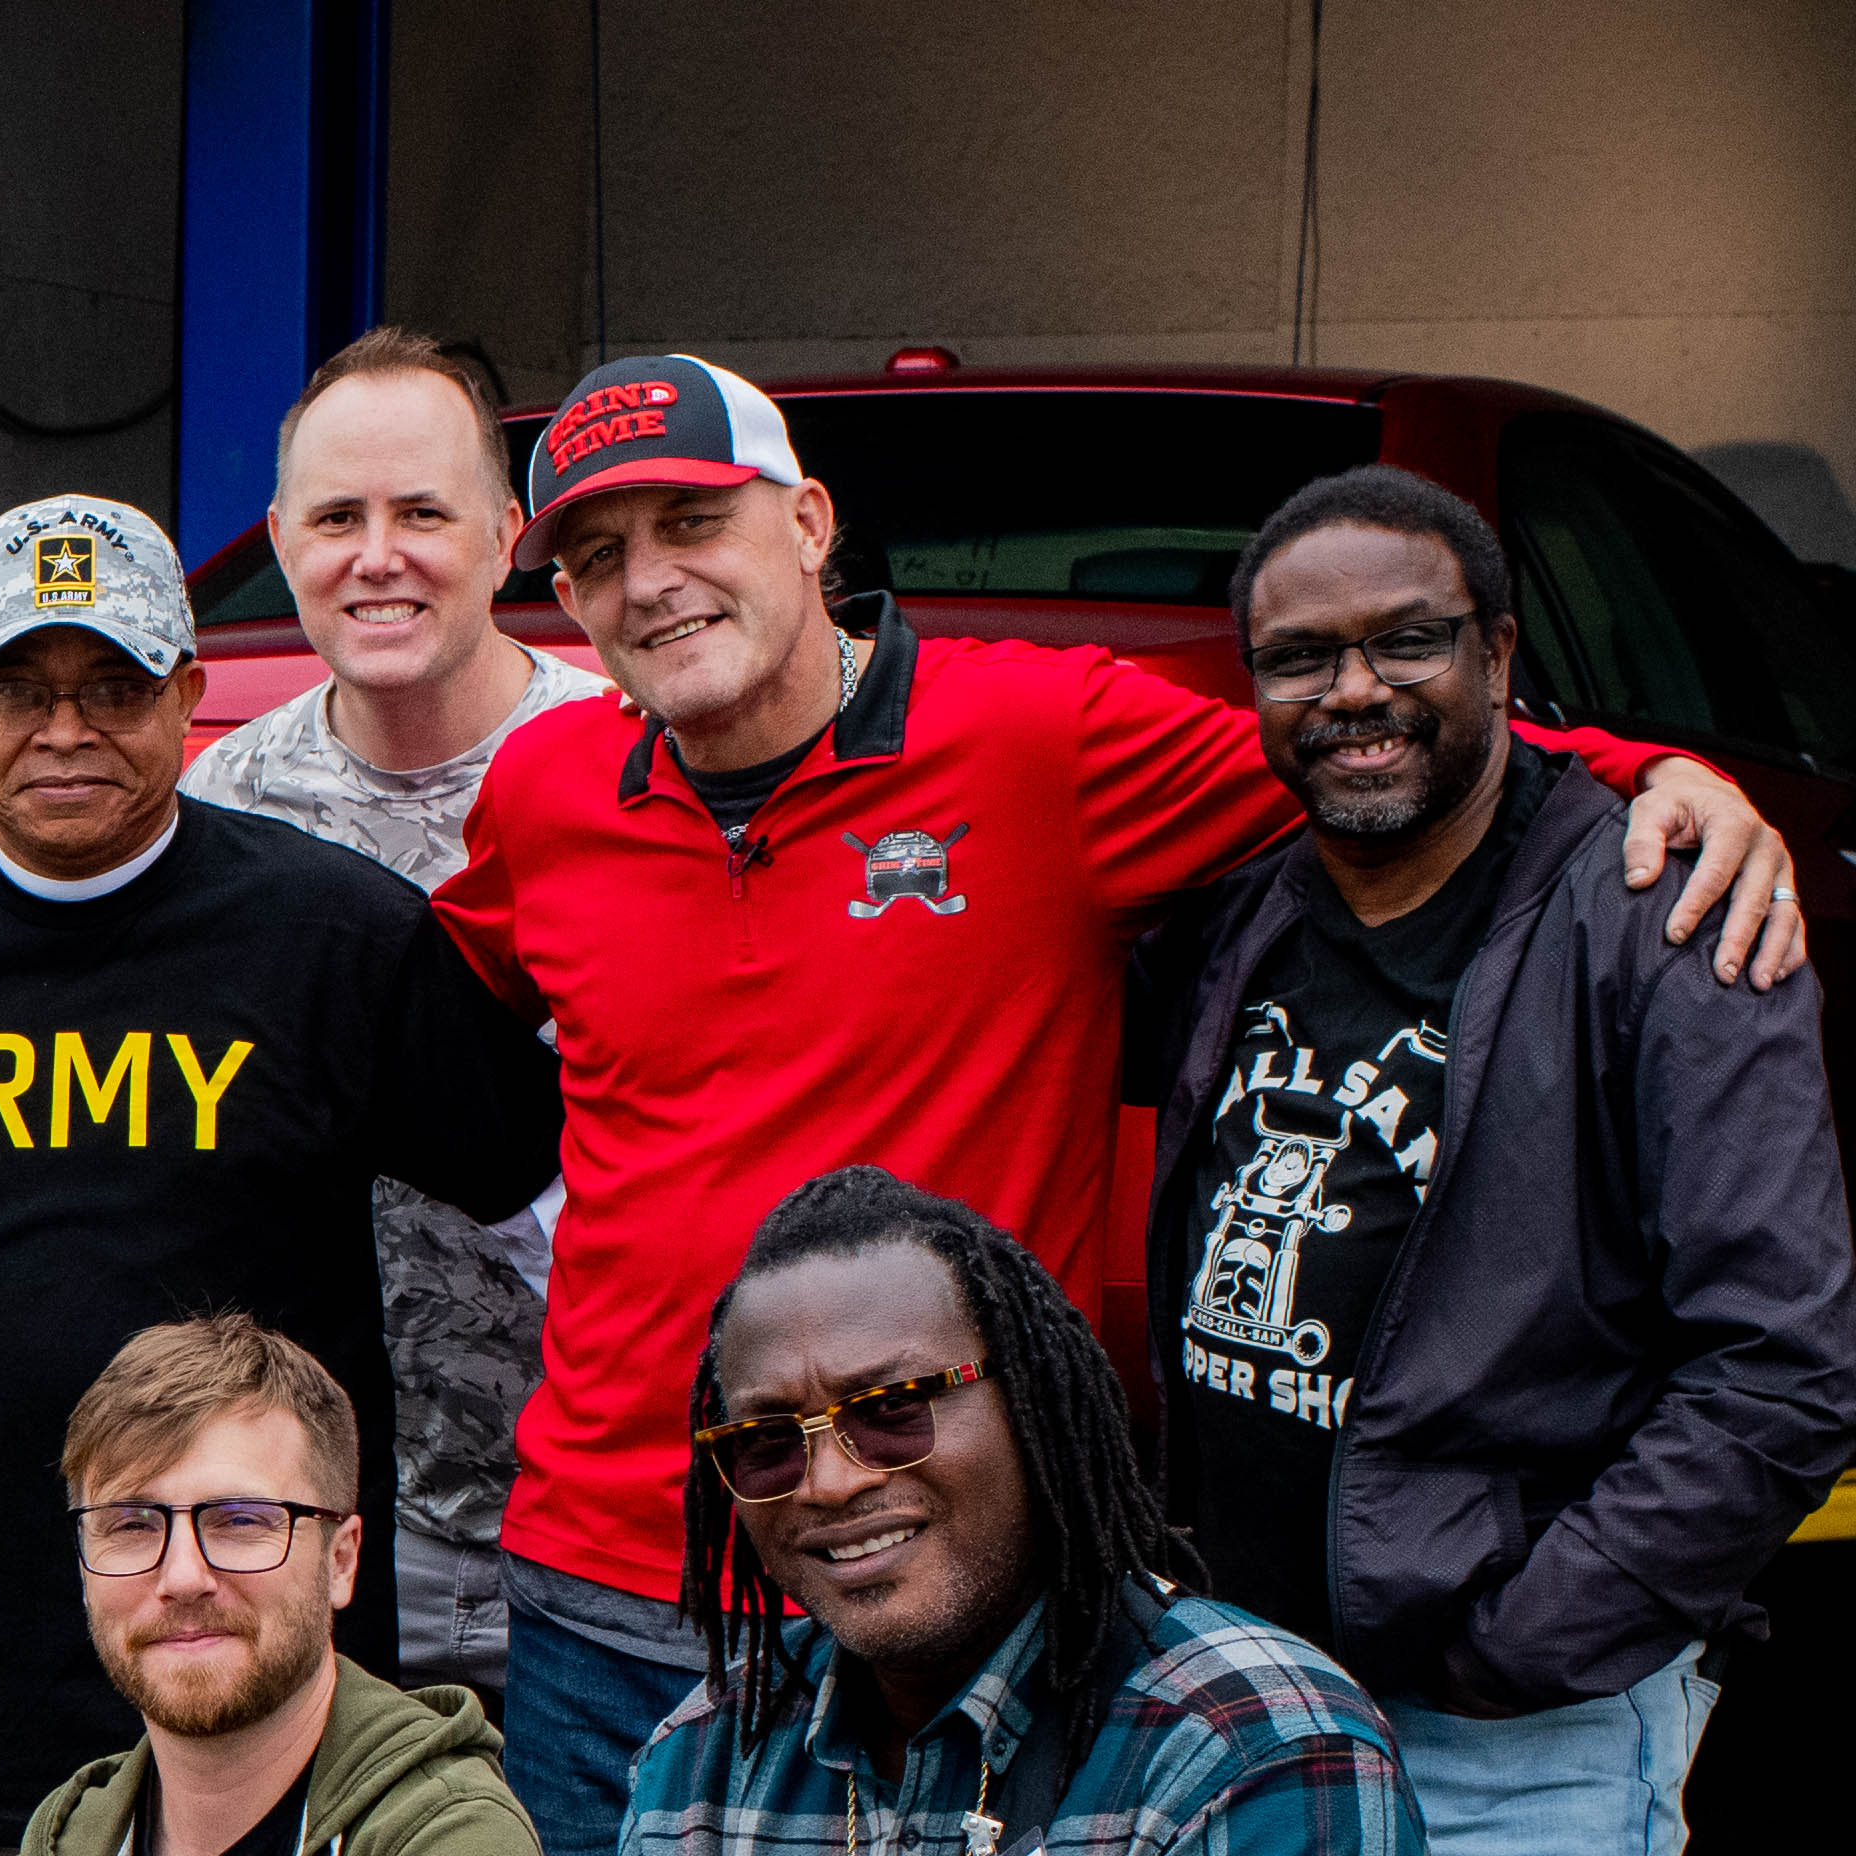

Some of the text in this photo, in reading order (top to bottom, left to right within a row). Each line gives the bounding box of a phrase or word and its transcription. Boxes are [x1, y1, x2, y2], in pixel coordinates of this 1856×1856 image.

[547, 380, 679, 454] GRIND
[552, 409, 667, 478] TIME
[6, 510, 129, 555] U.S. ARMY
[1213, 1048, 1324, 1144] ALL
